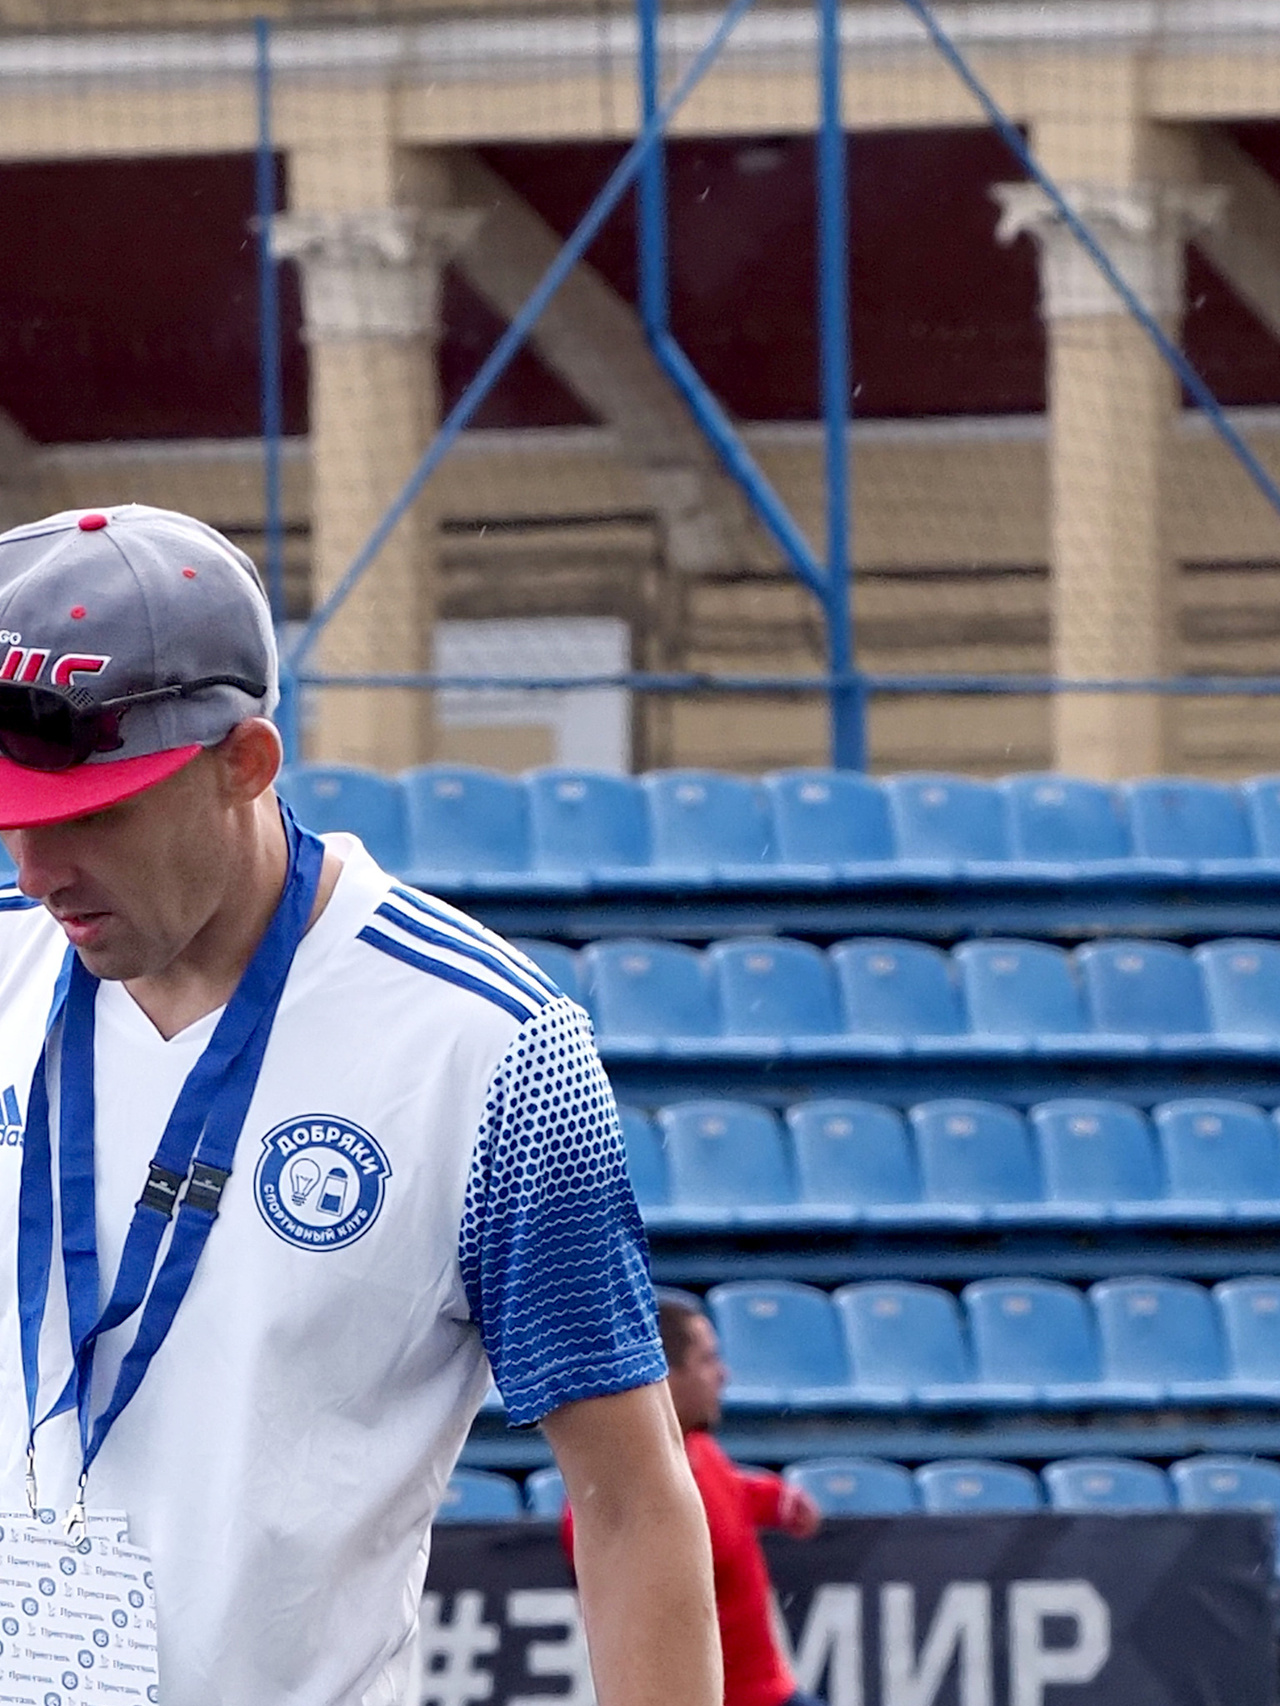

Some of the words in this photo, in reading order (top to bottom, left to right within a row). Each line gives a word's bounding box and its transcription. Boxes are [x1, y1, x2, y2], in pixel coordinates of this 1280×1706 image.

[276, 1125, 379, 1175] ДОБРЯКИ
[264, 1184, 336, 1242] СПОРТИВНЫЙ
[337, 1208, 369, 1237] КЛУБ
